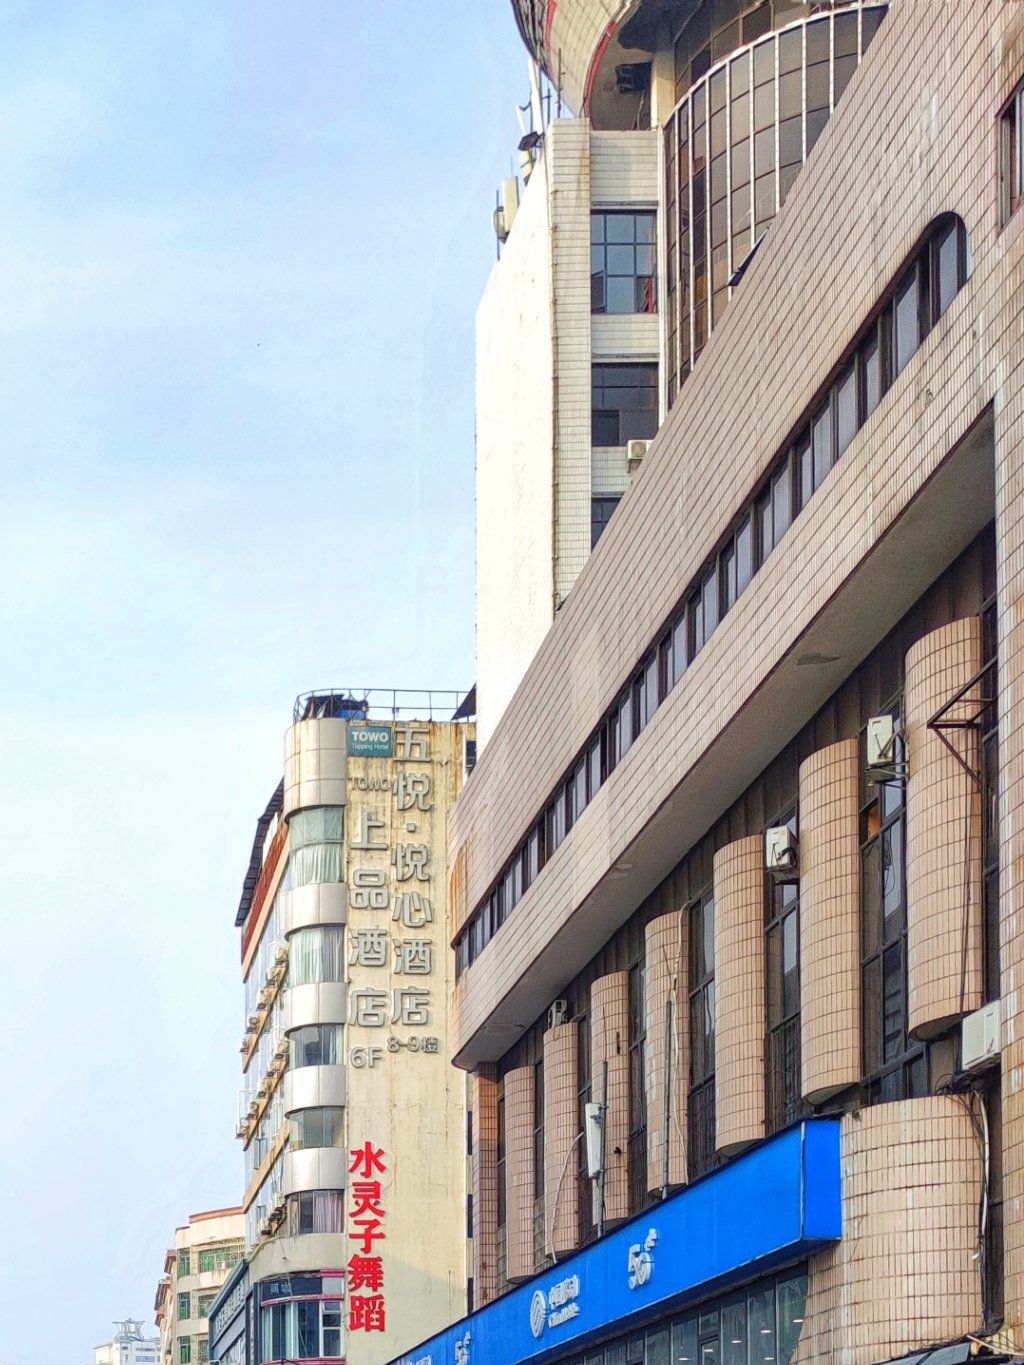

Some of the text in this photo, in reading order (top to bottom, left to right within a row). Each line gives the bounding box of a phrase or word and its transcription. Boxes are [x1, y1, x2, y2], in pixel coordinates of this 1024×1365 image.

[351, 731, 389, 742] TOWO
[349, 776, 392, 791] TOWO
[349, 806, 389, 1027] 上品酒店
[386, 1035, 439, 1054] 8-9楼
[350, 1046, 382, 1068] 6F
[348, 1141, 388, 1333] 水灵子舞蹈
[549, 1275, 579, 1310] 中国移动
